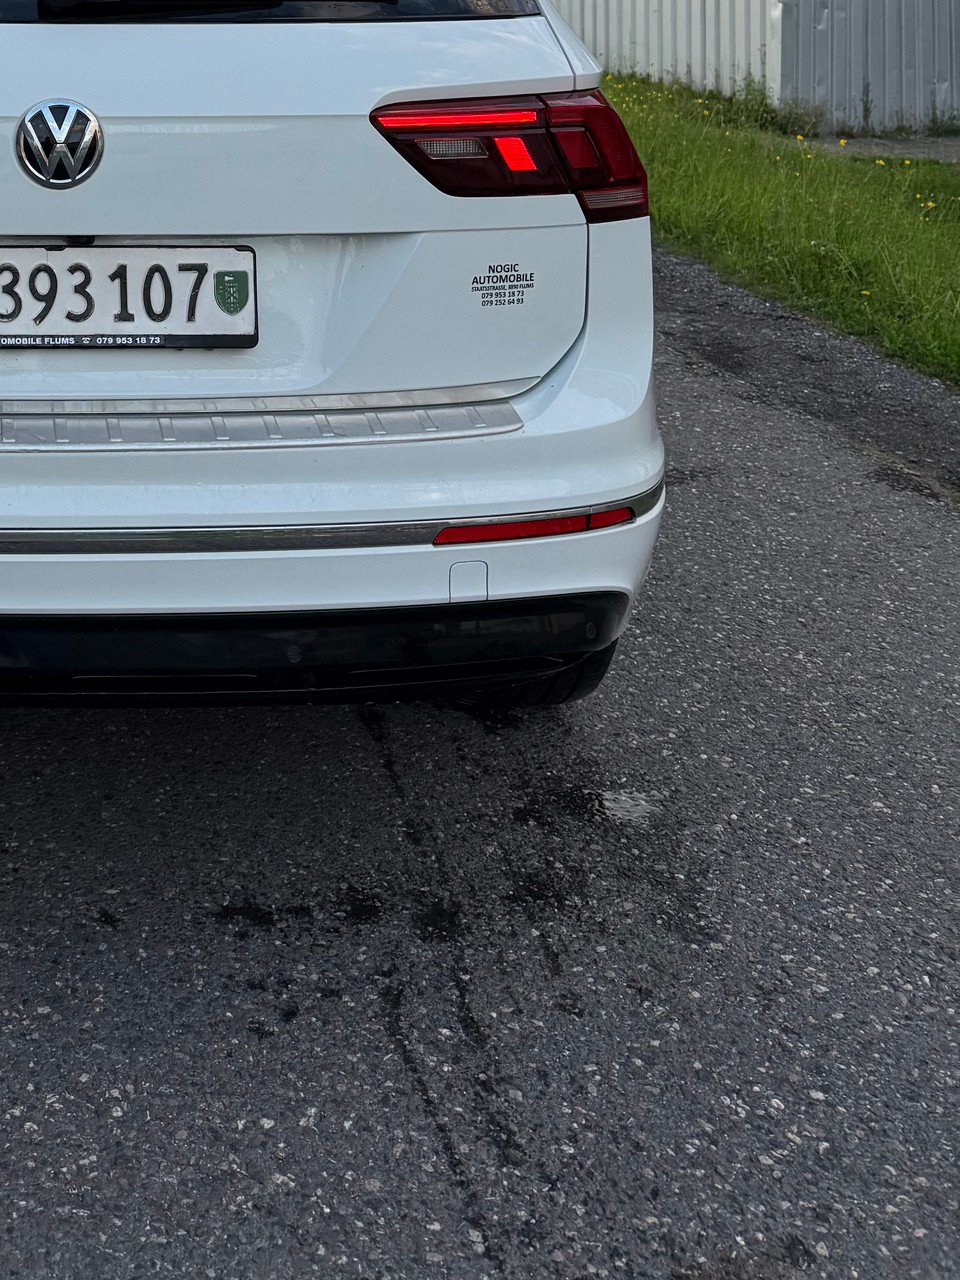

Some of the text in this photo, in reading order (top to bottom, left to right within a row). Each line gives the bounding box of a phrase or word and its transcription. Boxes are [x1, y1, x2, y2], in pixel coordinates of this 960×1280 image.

[19, 100, 101, 186] VW
[488, 263, 519, 274] NOGIC
[471, 272, 535, 285] AUTOMOBILE
[494, 291, 506, 299] 953
[508, 290, 515, 298] 18
[516, 297, 524, 305] 93
[44, 337, 75, 345] FLUMS
[135, 336, 147, 344] 18
[149, 336, 161, 344] 73
